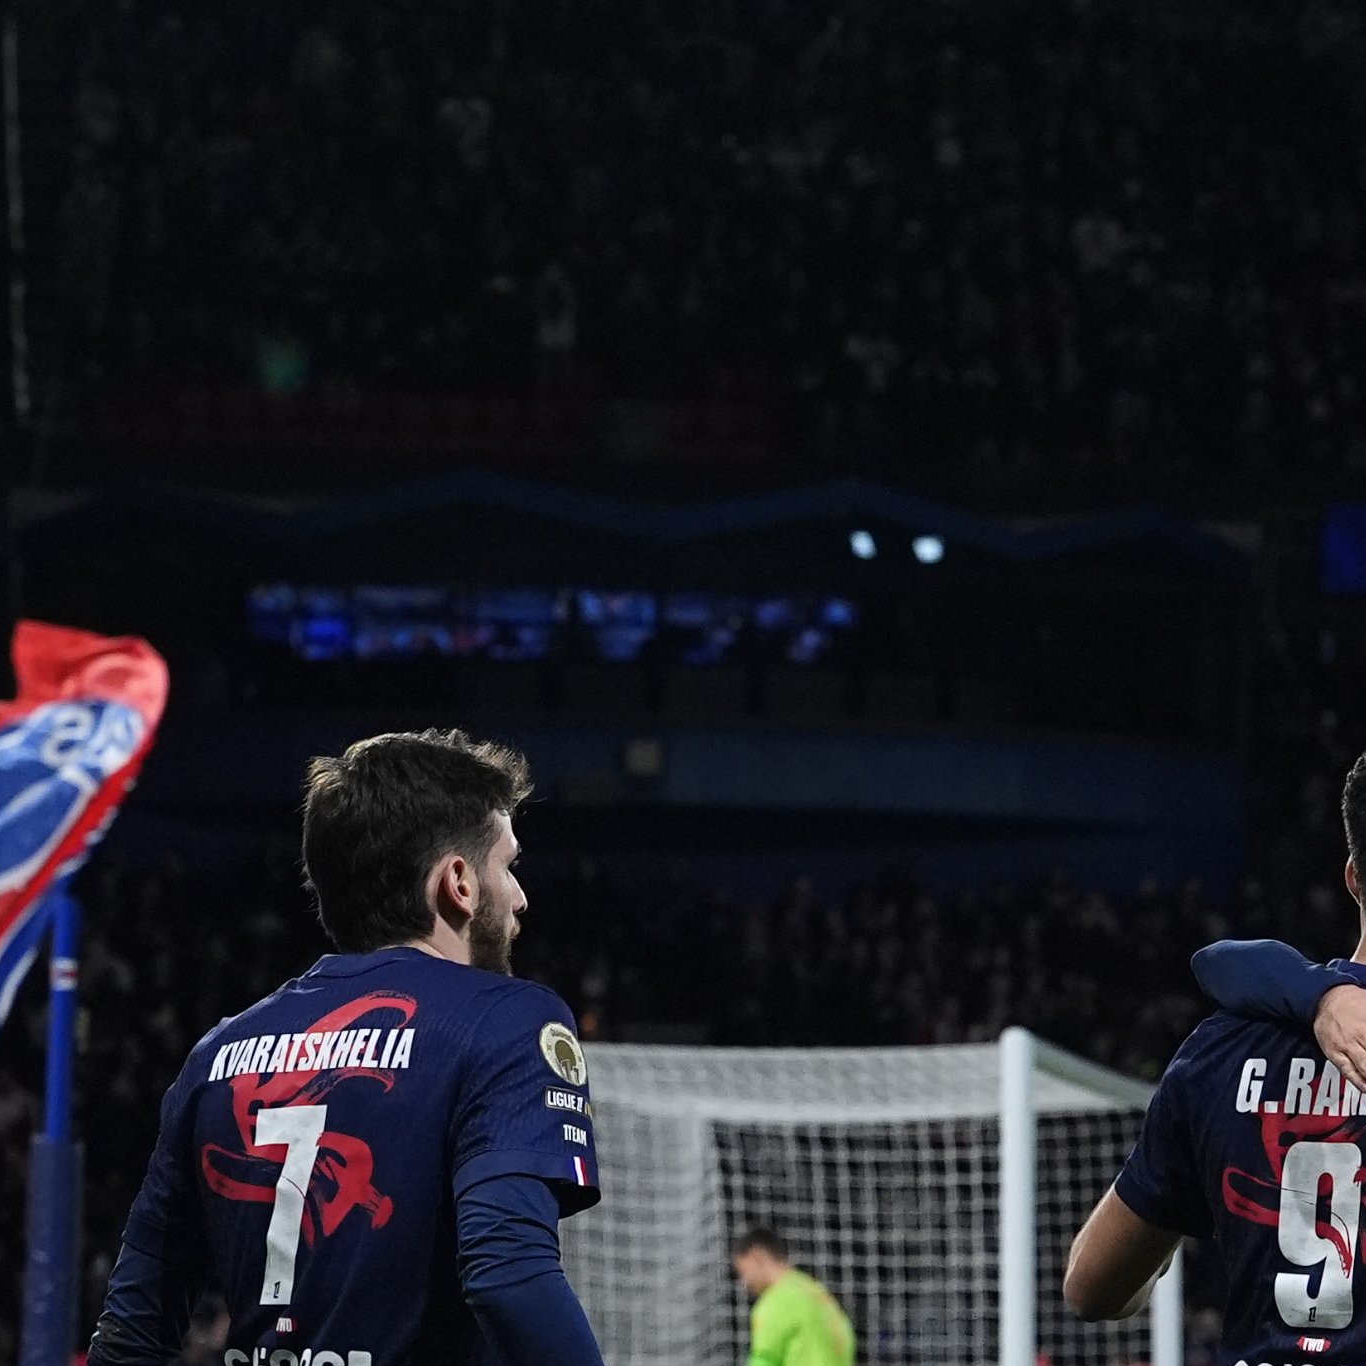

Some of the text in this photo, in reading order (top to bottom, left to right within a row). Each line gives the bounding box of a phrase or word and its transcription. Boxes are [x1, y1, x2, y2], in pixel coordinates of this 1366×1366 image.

[208, 1028, 415, 1082] KVARATSKHELIA
[254, 1104, 328, 1305] 7
[1274, 1142, 1362, 1330] 9
